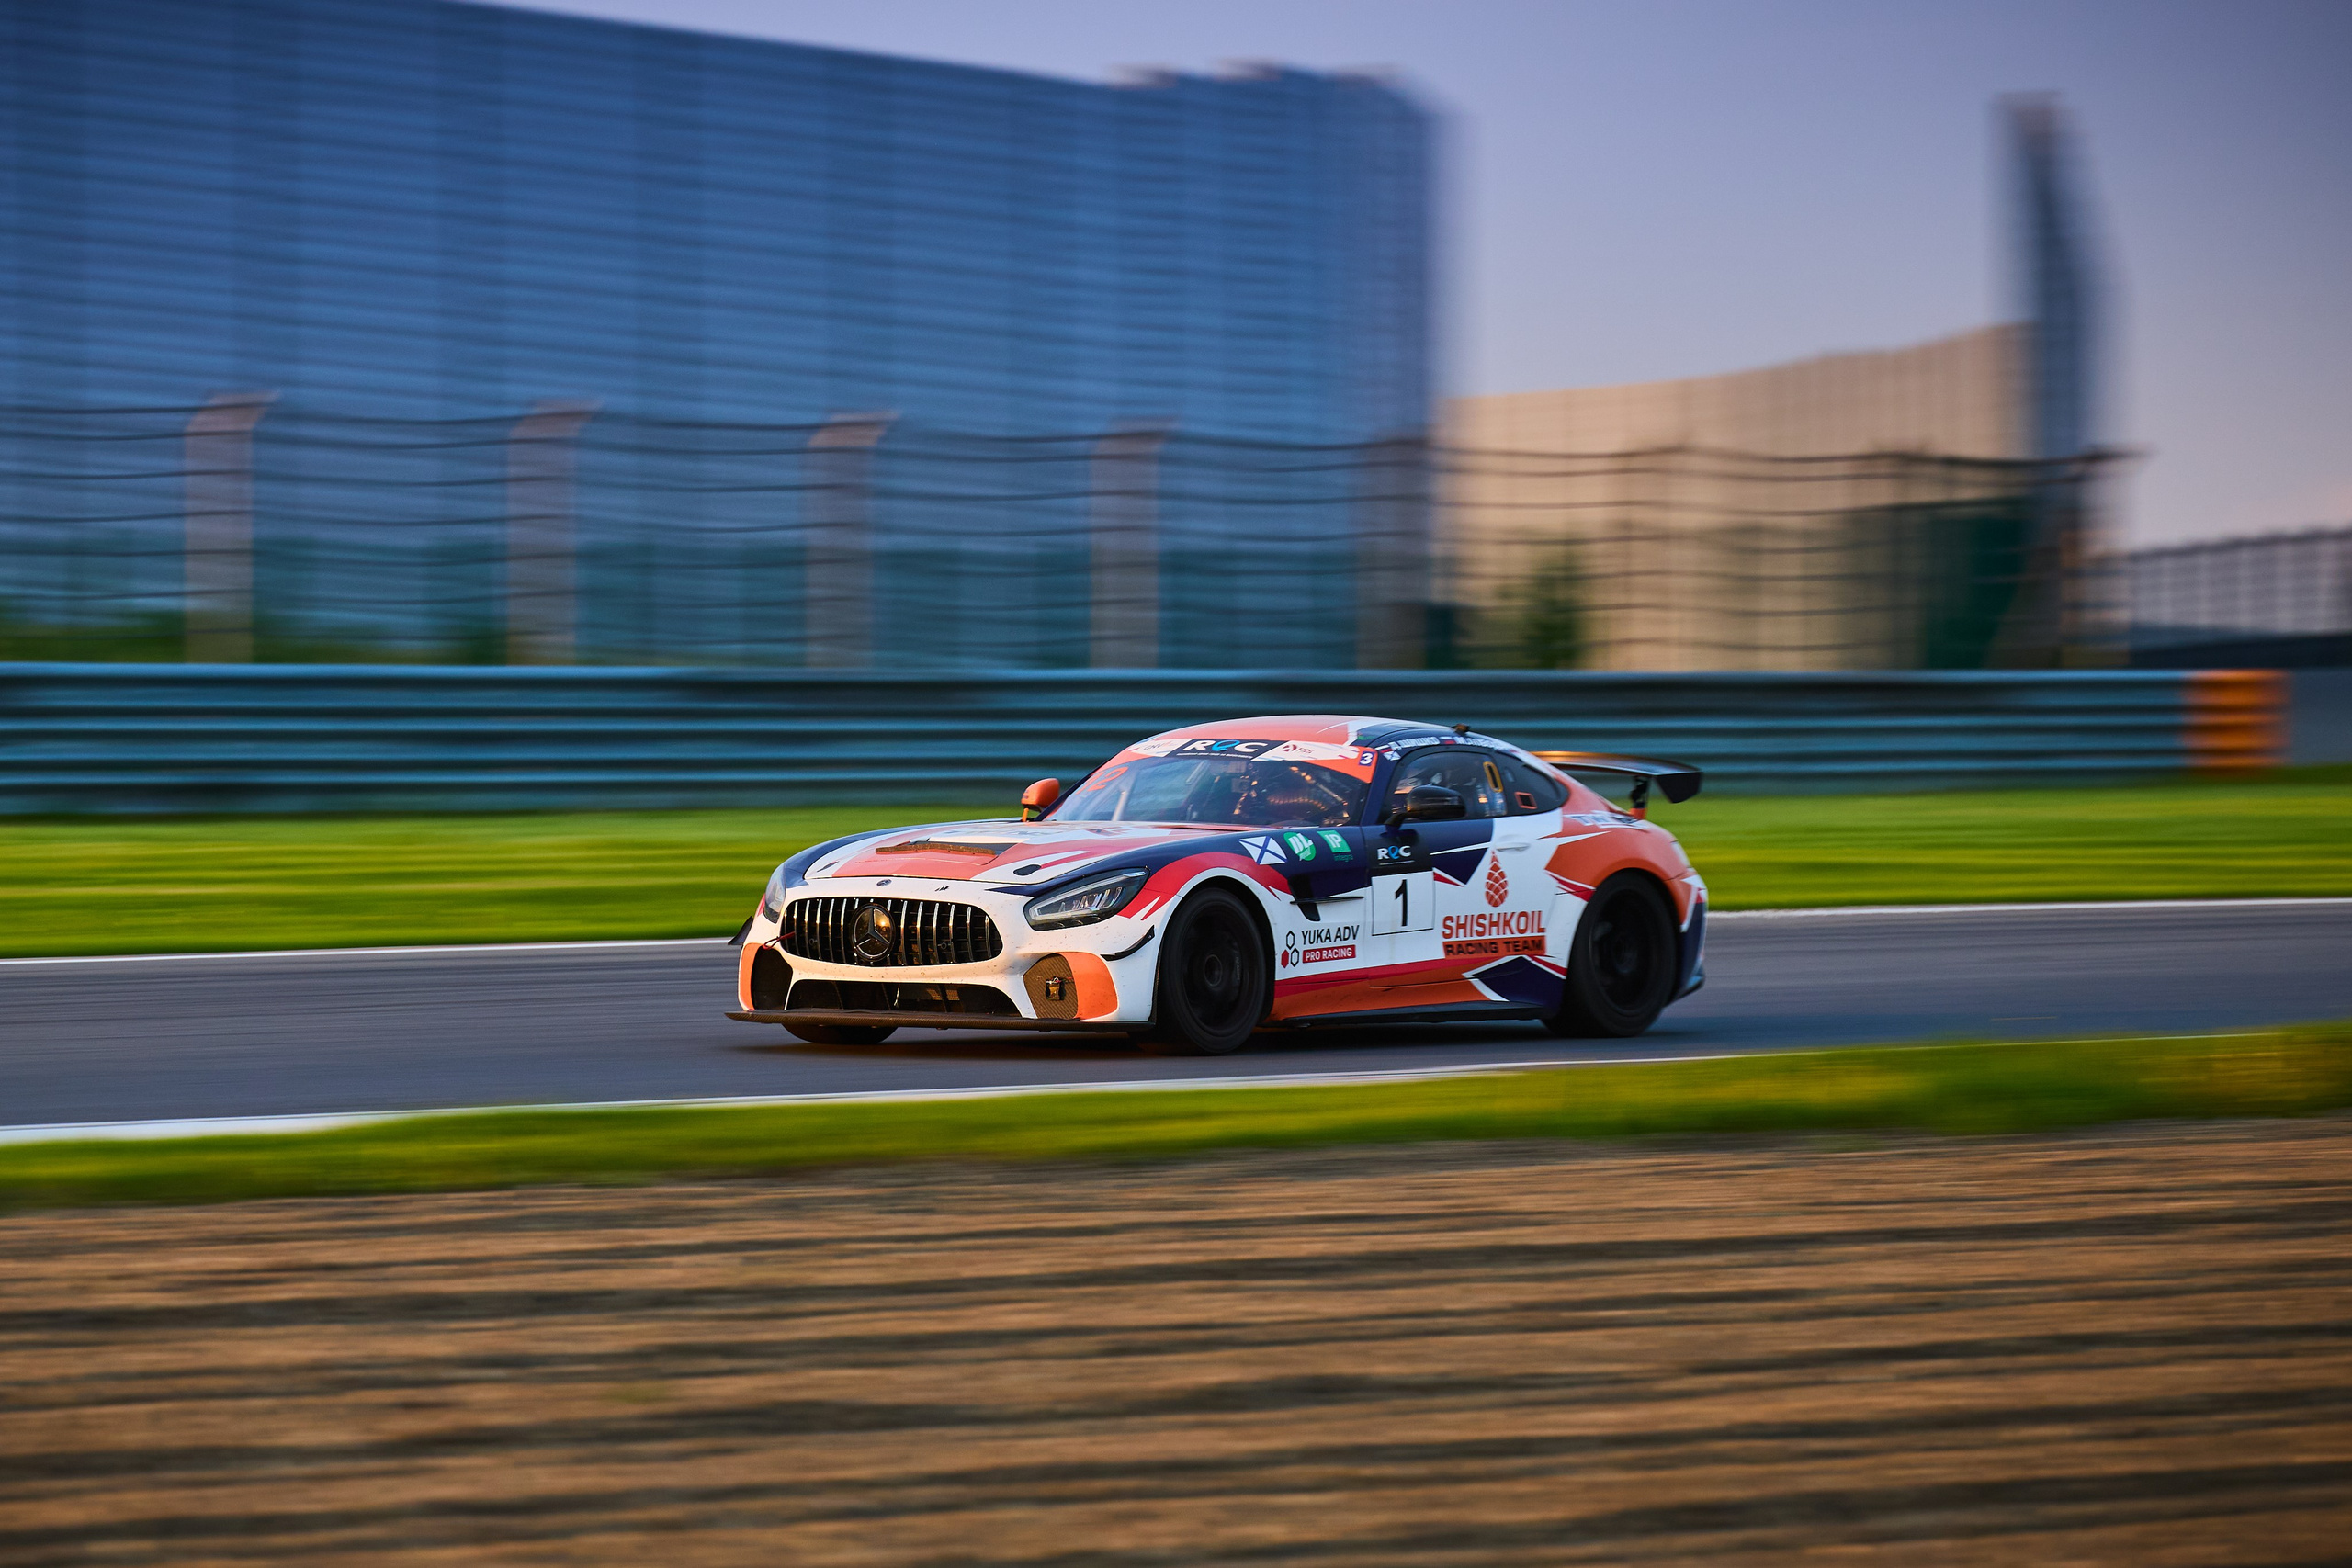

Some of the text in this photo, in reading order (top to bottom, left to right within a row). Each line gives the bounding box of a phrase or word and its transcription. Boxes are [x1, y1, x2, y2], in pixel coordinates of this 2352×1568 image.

[1360, 752, 1374, 765] 3
[1325, 834, 1343, 849] IP
[1395, 879, 1408, 927] 1
[1442, 910, 1546, 939] SHISHKOIL
[1301, 924, 1360, 945] YUKA ADV
[1306, 947, 1352, 962] PRO RACING
[1445, 939, 1544, 956] RACING TEAM
